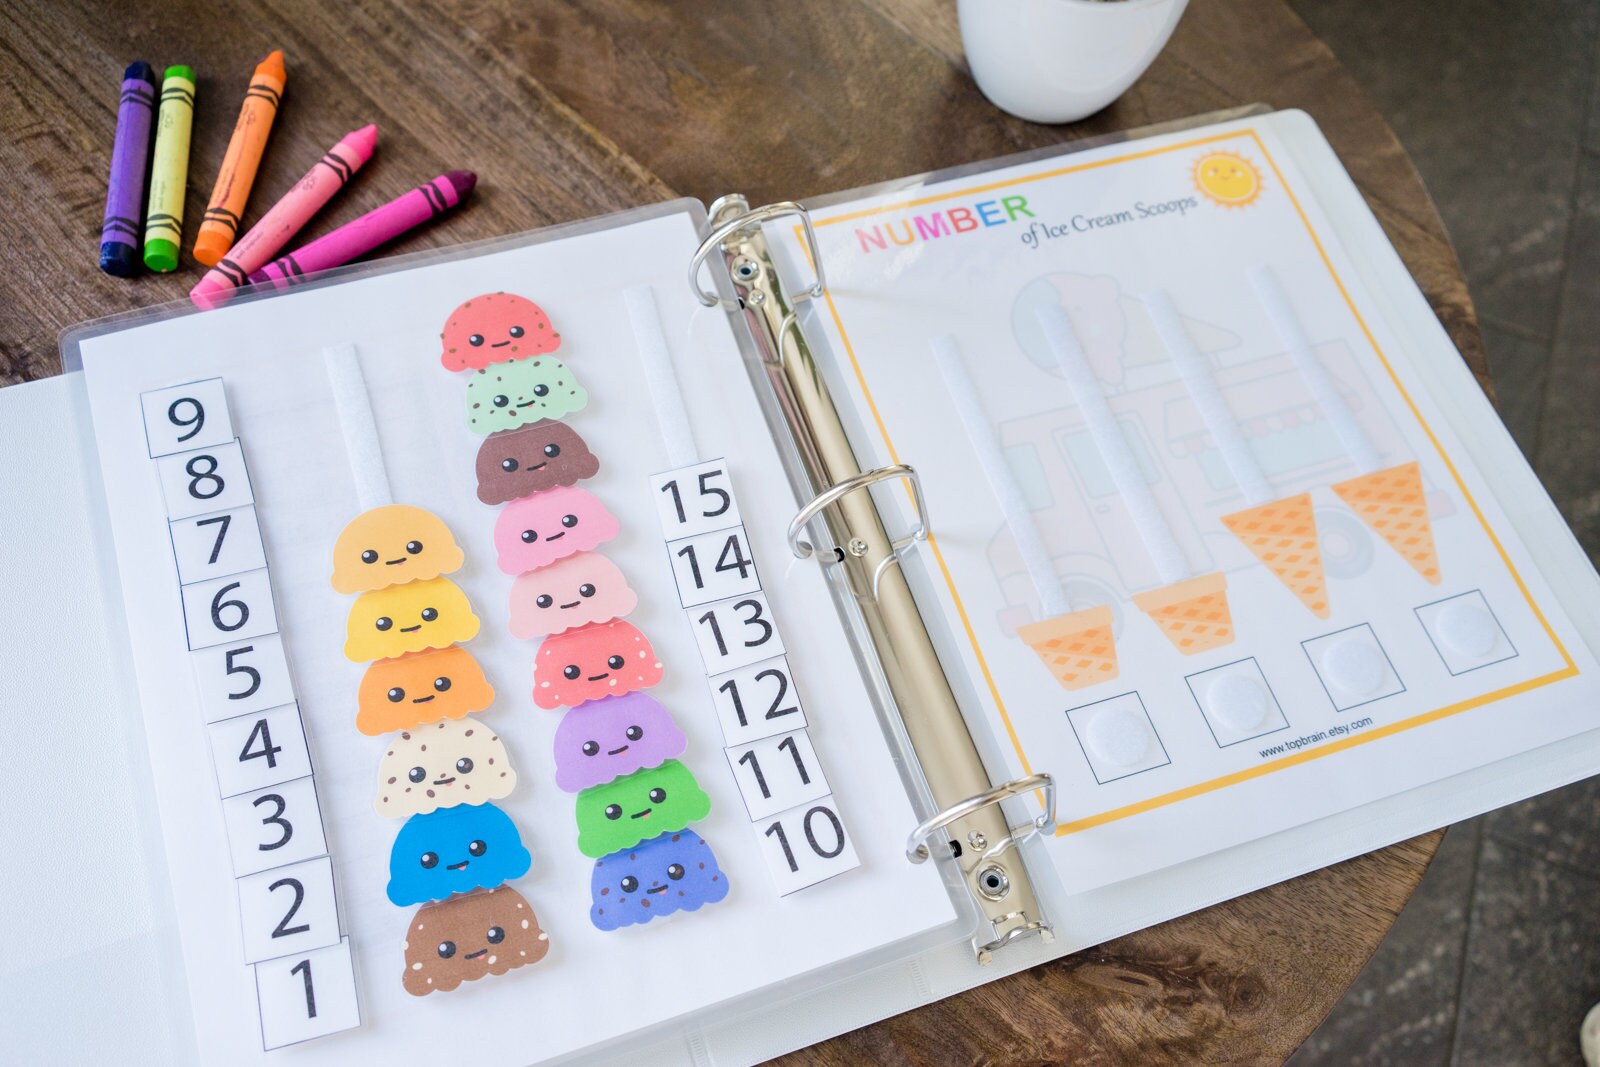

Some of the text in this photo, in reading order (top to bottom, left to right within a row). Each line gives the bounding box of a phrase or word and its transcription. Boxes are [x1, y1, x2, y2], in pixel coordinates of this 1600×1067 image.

[855, 194, 1036, 254] NUMBER
[1021, 195, 1199, 249] of Ice Cream Scoops
[168, 397, 205, 443] 9
[186, 454, 225, 500] 8
[661, 469, 731, 523] 15
[196, 514, 232, 565] 7
[677, 534, 752, 589] 14
[210, 581, 250, 632] 6
[698, 599, 773, 657] 13
[226, 645, 261, 700] 5
[719, 669, 799, 727] 12
[239, 718, 282, 769] 4
[1259, 716, 1373, 758] www.topbrain.etsy.com
[738, 736, 811, 799] 11
[253, 793, 293, 851] 3
[765, 806, 845, 872] 10
[268, 878, 310, 939] 2
[290, 959, 317, 1018] 1
